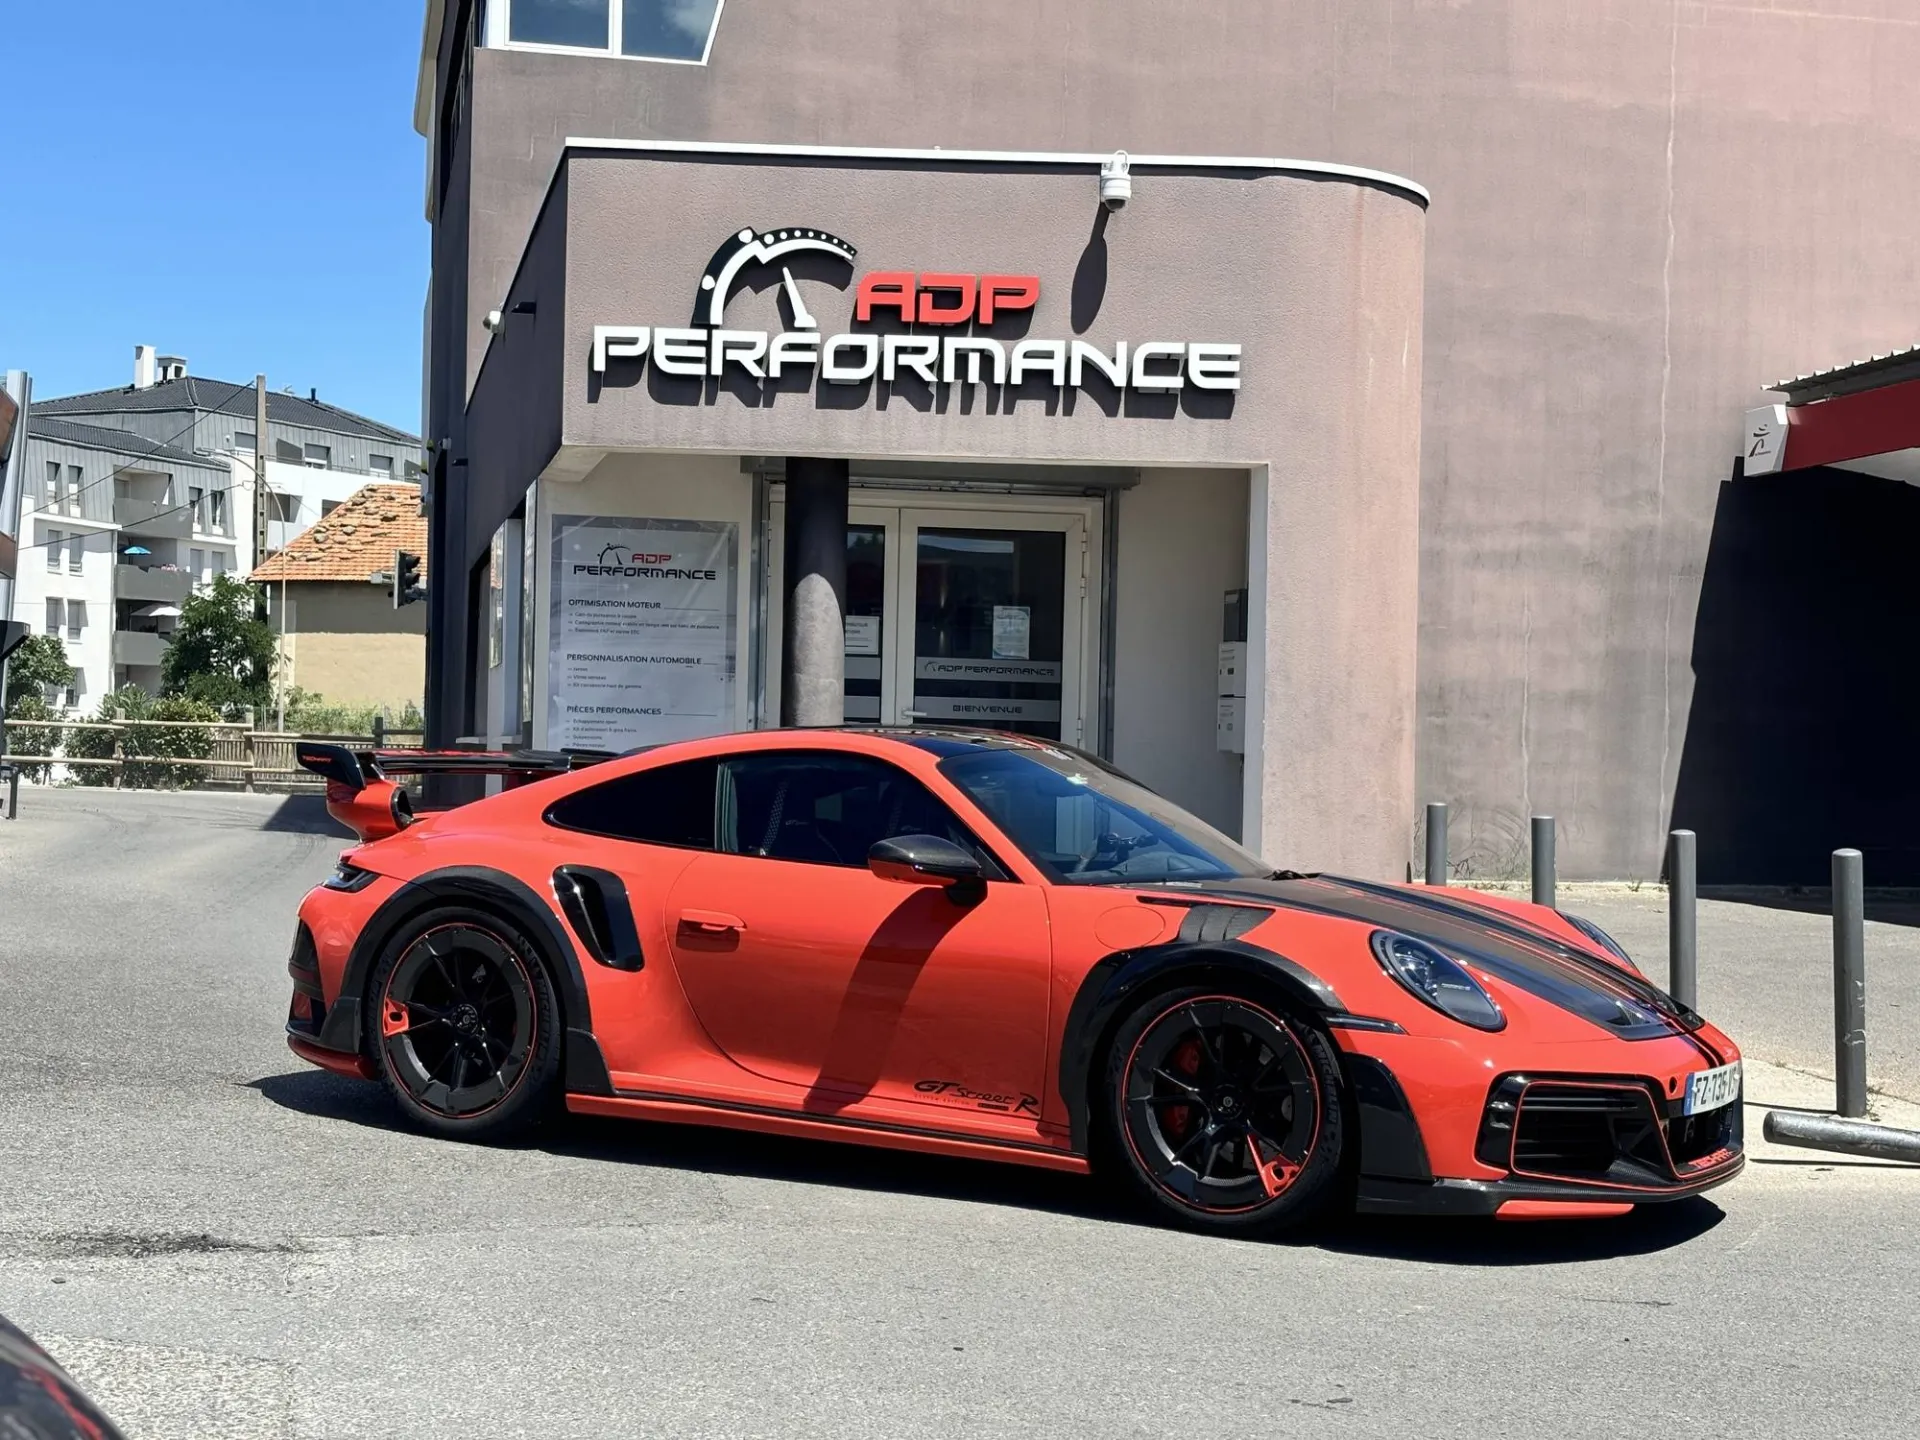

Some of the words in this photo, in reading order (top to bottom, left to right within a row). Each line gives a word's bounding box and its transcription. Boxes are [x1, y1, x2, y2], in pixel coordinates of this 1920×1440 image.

[857, 271, 1040, 324] ADP
[592, 325, 1242, 390] PERFORMANCE
[631, 553, 672, 564] ADP
[573, 565, 716, 580] PERFORMANCE
[568, 598, 626, 608] OPTIMISATION
[627, 601, 661, 609] MOTEUR
[566, 653, 648, 663] PERSONNALISATION
[649, 656, 701, 665] AUTOMOBILE
[938, 664, 962, 673] ADP
[964, 665, 1055, 676] PERFORMANCE
[566, 704, 595, 714] PIÈCES
[595, 706, 662, 715] PERFORMANCES
[952, 704, 1023, 714] BIENVENUE
